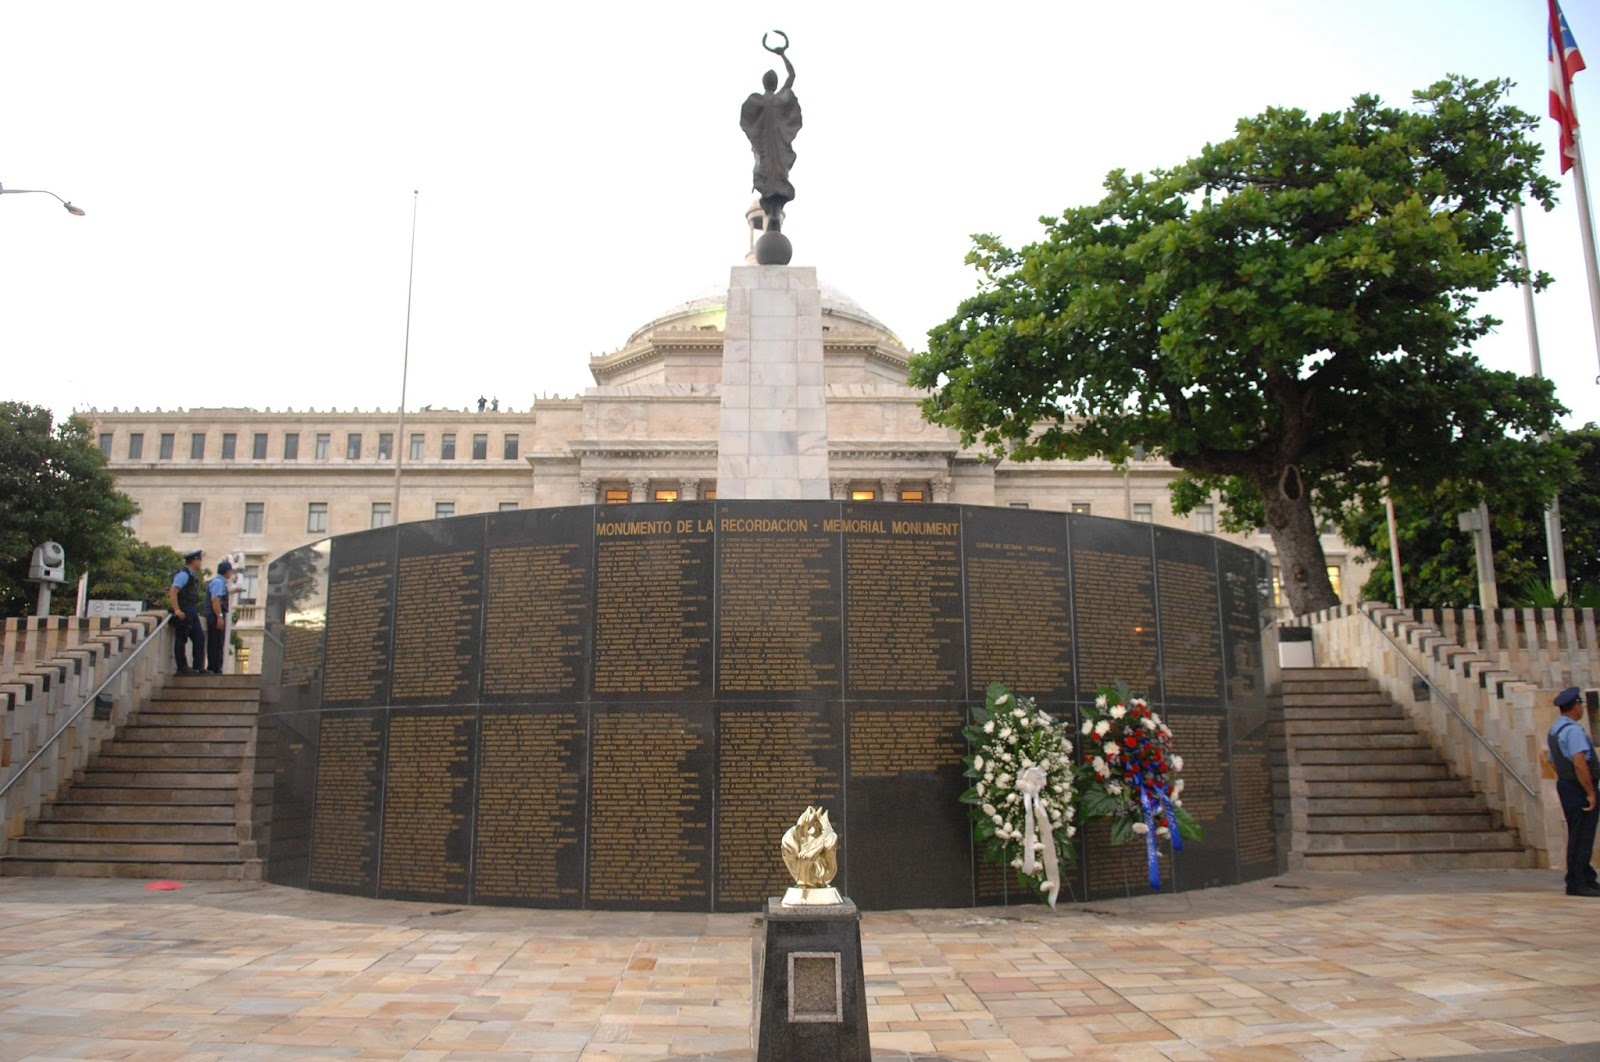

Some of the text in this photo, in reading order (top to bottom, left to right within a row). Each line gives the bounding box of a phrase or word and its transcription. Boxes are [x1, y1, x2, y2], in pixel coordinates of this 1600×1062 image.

[597, 521, 672, 535] MONUMENTO
[677, 519, 693, 533] DE
[698, 519, 714, 532] LA
[721, 519, 808, 532] RECORDACION
[823, 519, 887, 533] MEMORIAL
[892, 521, 959, 536] MONUMENT
